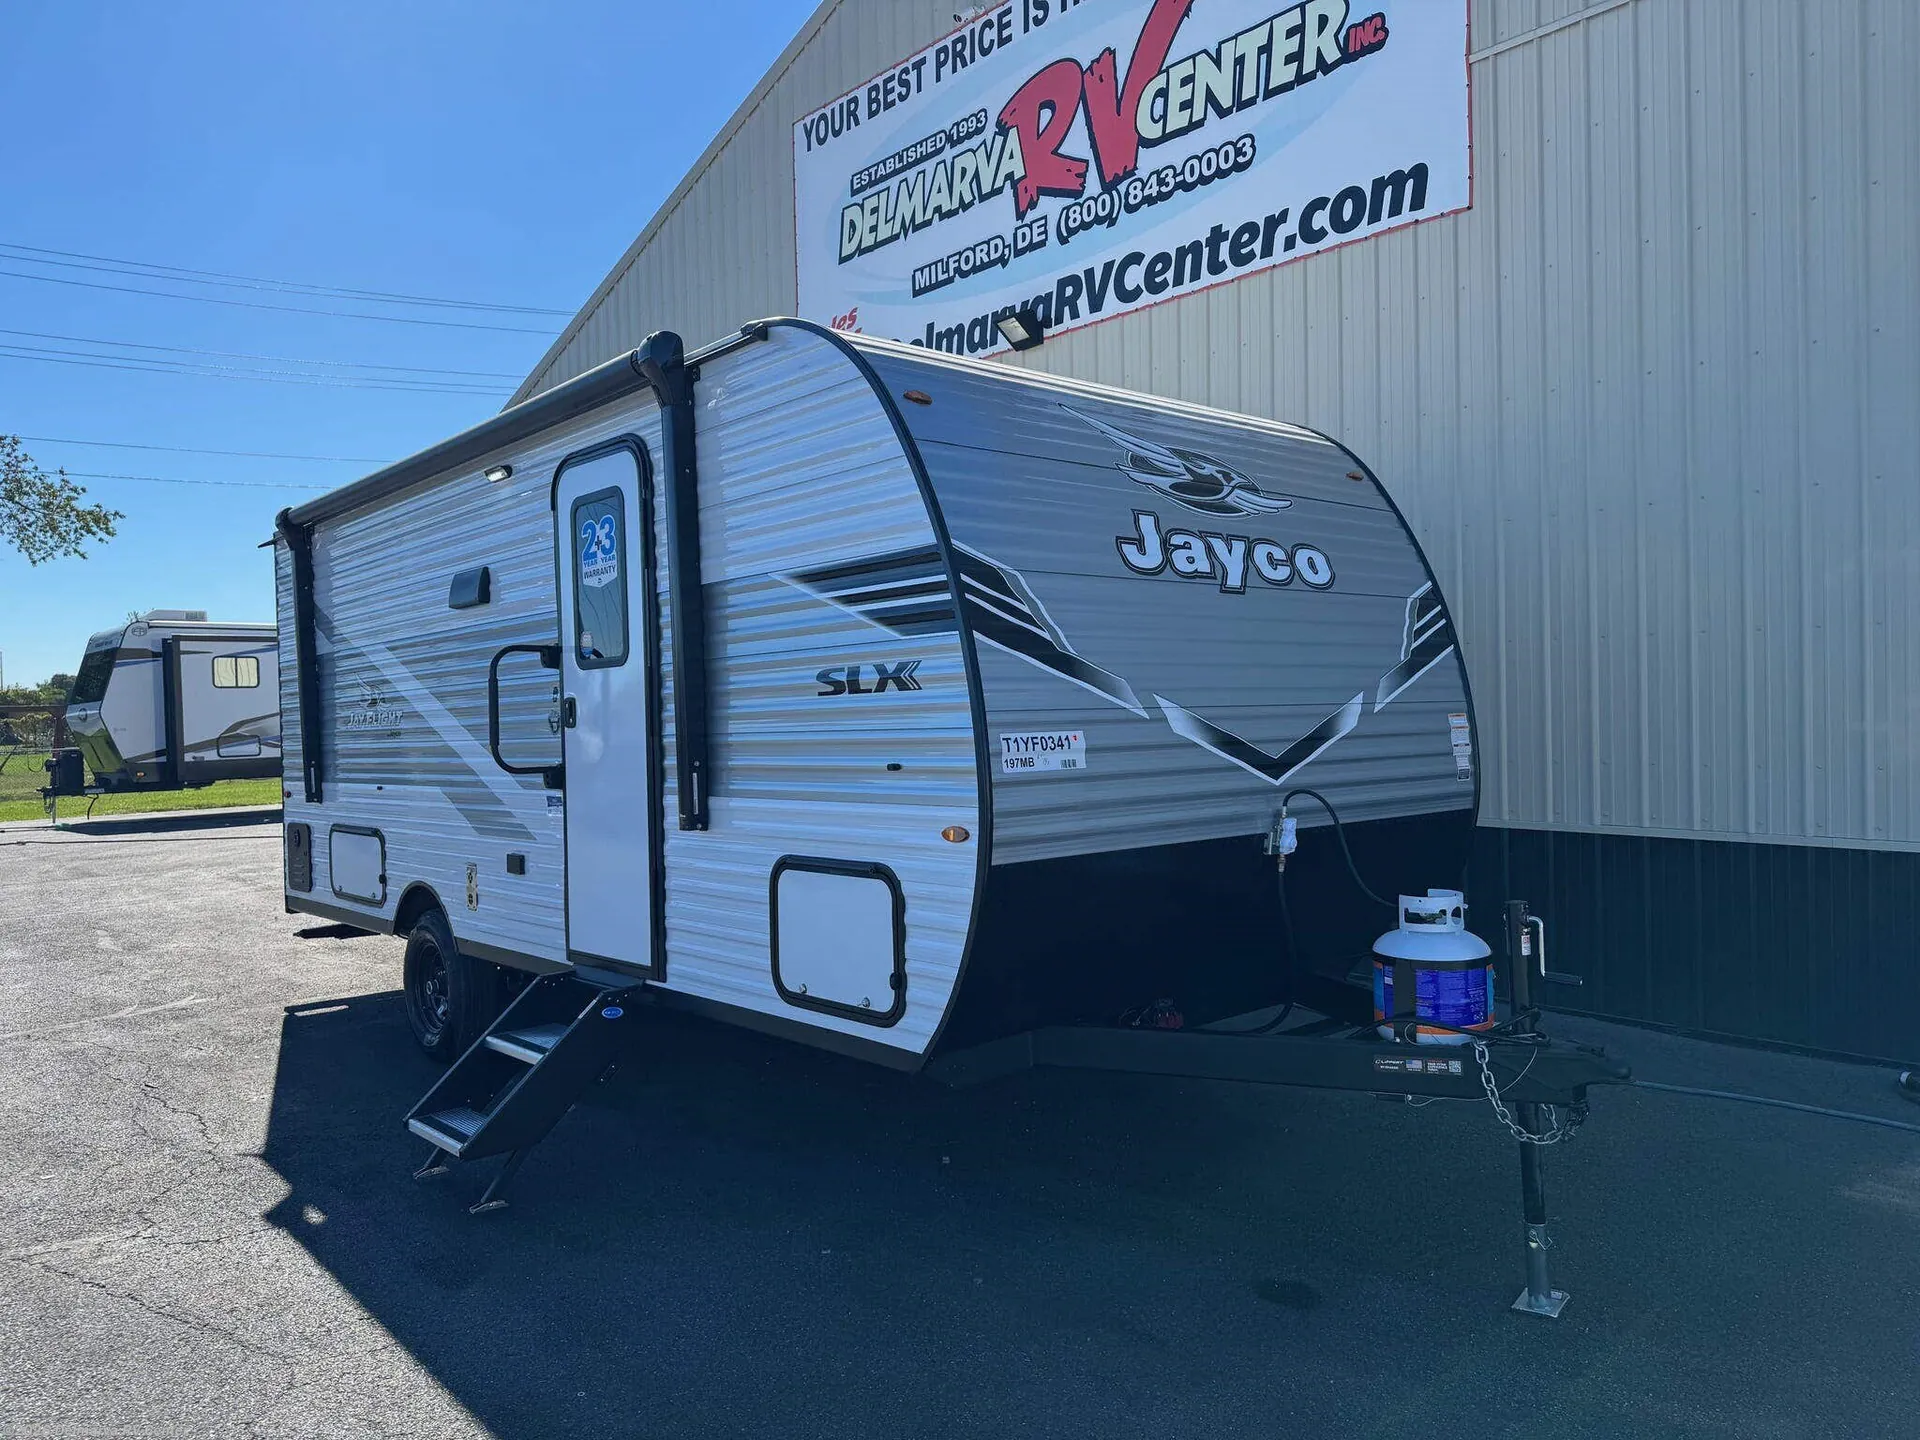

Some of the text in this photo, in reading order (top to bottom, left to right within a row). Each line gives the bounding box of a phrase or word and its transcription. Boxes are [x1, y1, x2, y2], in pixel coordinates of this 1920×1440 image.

[803, 0, 1050, 153] YOUR BEST PRICE IS
[838, 0, 1389, 266] DELMARVA RV CENTER INC.
[850, 107, 988, 197] ESTABLISHED 1993
[912, 133, 1256, 299] MILFORD, DE (800) 843-0003
[583, 564, 616, 580] WARRANTY
[1115, 508, 1336, 595] Jayco
[815, 659, 923, 697] SLX
[366, 710, 403, 727] FLIGHT
[1002, 735, 1072, 753] T1YF0341
[1004, 757, 1035, 769] 197MB
